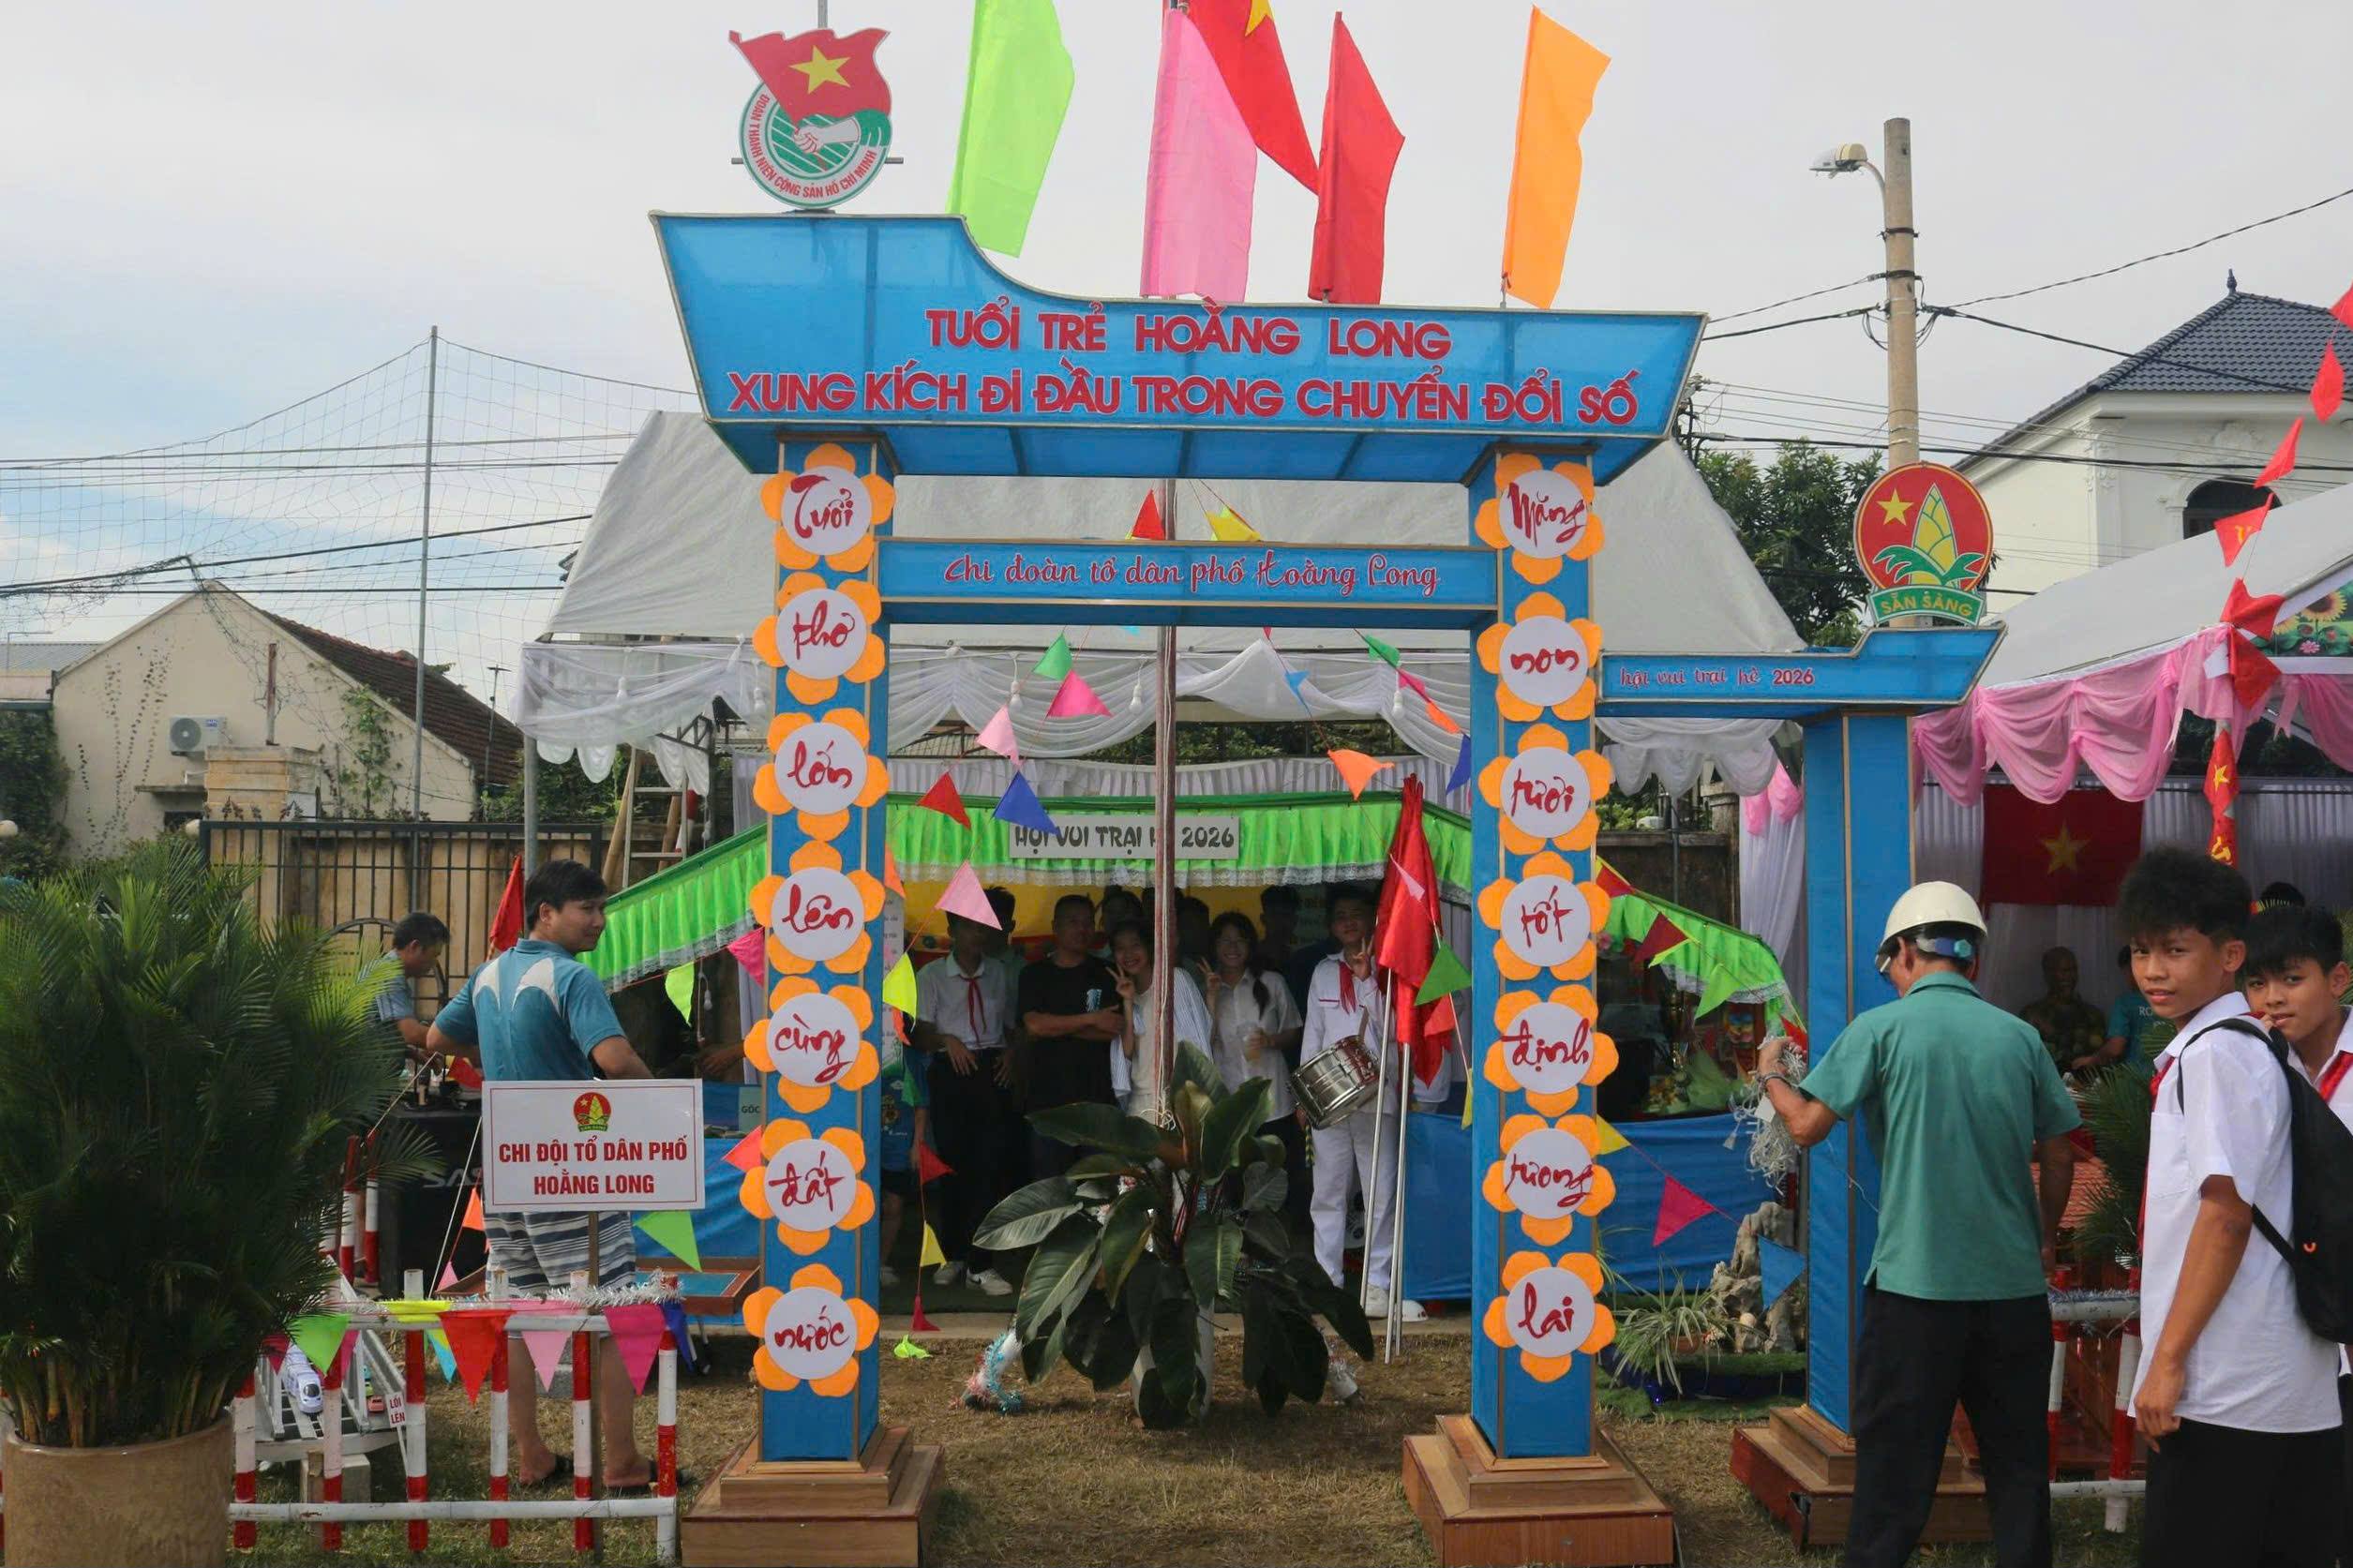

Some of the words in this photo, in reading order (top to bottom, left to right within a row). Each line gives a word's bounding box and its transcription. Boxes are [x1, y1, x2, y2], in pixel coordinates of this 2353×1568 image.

[747, 123, 764, 161] THANH
[853, 149, 878, 180] MINH
[924, 295, 1021, 351] TUỔI
[1037, 300, 1107, 352] TRẺ
[1134, 294, 1302, 356] HOẰNG
[1328, 318, 1452, 361] LONG
[727, 372, 857, 413] XUNG
[864, 359, 967, 412] KÍCH
[978, 368, 1023, 413] ĐI
[1032, 356, 1121, 415] ĐẦU
[1131, 375, 1285, 418] TRONG
[1296, 365, 1470, 422] CHUYỂN
[1481, 367, 1564, 425] ĐỔI
[1577, 369, 1639, 426] SỐ
[790, 474, 854, 539] Tuổi
[1506, 481, 1588, 547] Măng
[943, 553, 994, 582] Chi
[1004, 553, 1080, 583] đoàn
[1124, 555, 1183, 584] dân
[1191, 555, 1247, 593] phố
[1368, 553, 1440, 597] Long
[792, 599, 856, 660] thơ
[1510, 647, 1581, 675] non
[1694, 666, 1727, 687] trại
[1772, 666, 1816, 686] 2026
[787, 739, 852, 789] lớn
[1511, 768, 1574, 816] tươi
[1056, 825, 1089, 847] VUI
[1095, 825, 1143, 855] TRẠI
[1181, 826, 1235, 848] 2026
[780, 882, 854, 934] lên
[1521, 885, 1573, 948] tốt
[773, 1013, 854, 1083] cùng
[1501, 1017, 1592, 1073] định
[499, 1142, 531, 1163] CHI
[535, 1139, 569, 1166] ĐỘI
[573, 1135, 598, 1163] TỔ
[603, 1138, 643, 1162] DÂN
[648, 1135, 688, 1162] PHỐ
[533, 1169, 600, 1196] HOẰNG
[605, 1174, 655, 1195] LONG
[768, 1150, 845, 1211] đất
[774, 1304, 851, 1352] nước
[1518, 1281, 1574, 1339] lai
